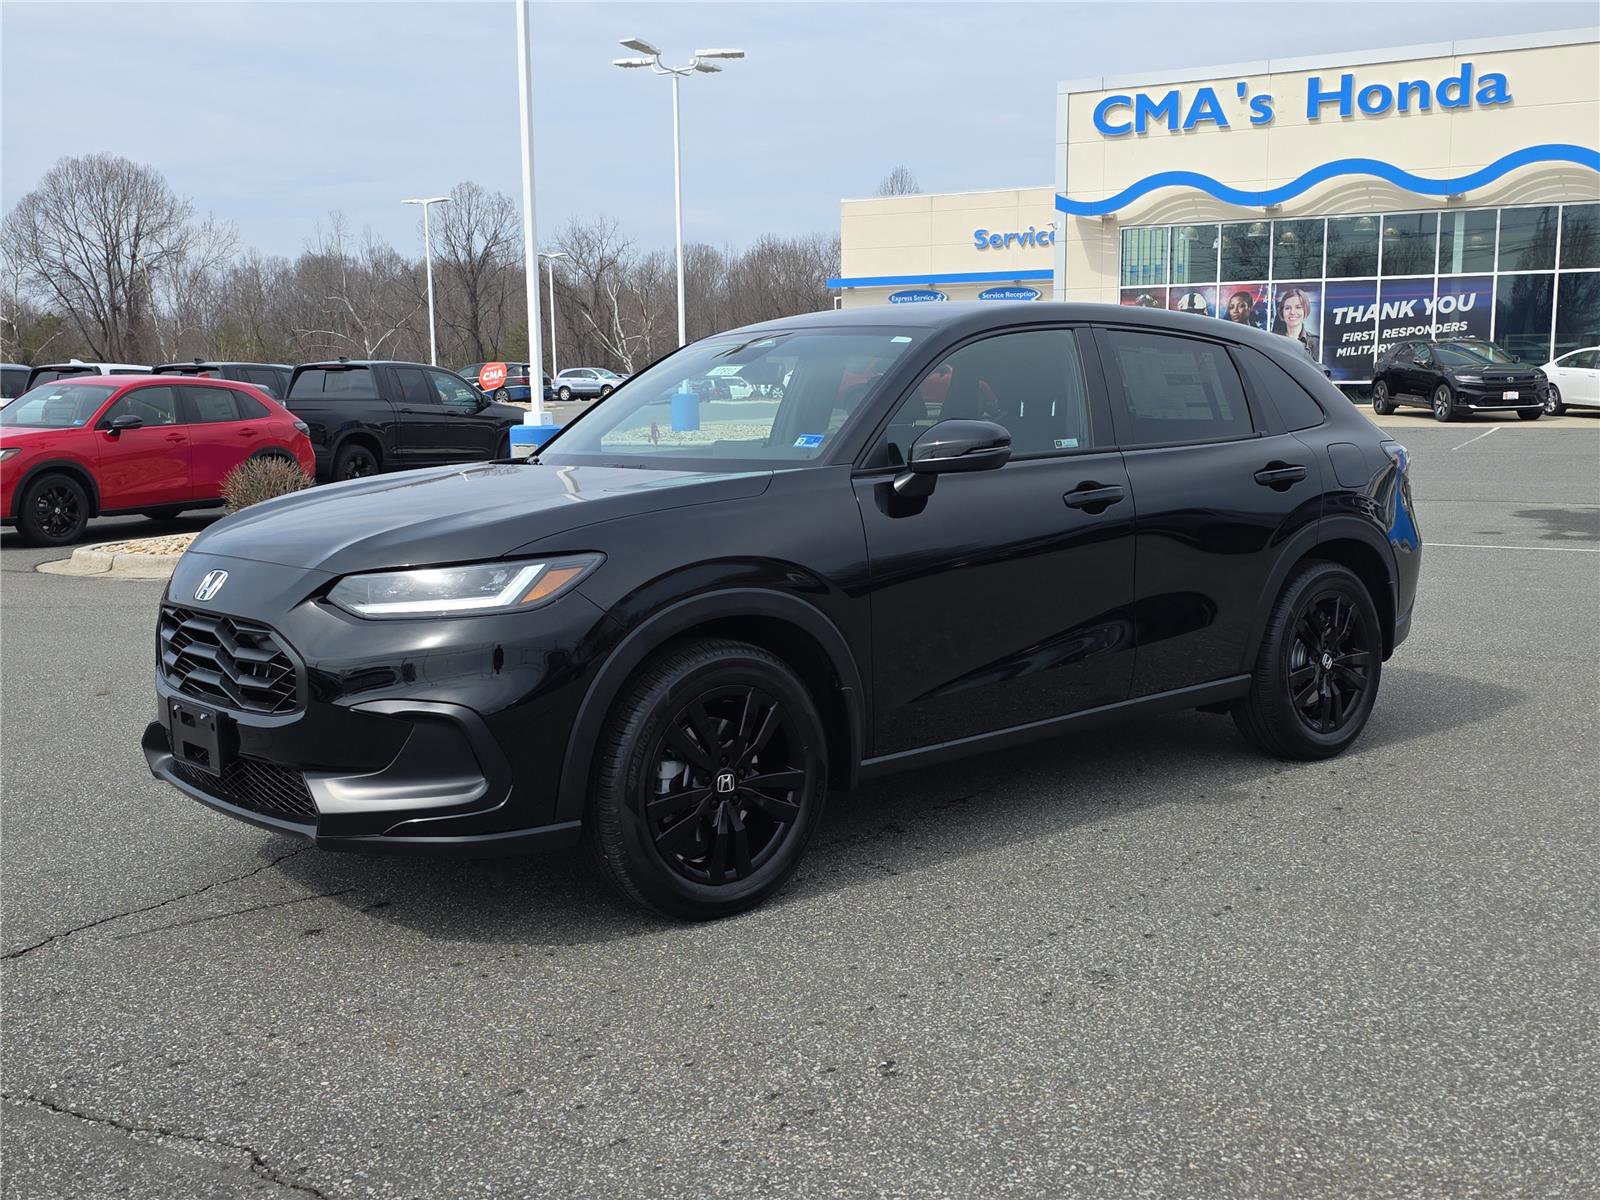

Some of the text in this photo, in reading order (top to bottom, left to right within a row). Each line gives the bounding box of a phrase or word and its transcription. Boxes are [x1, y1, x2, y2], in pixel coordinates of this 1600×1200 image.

[1093, 63, 1512, 136] CMA's Honda
[891, 294, 934, 303] Express Service
[1005, 290, 1036, 299] Reception
[1333, 293, 1476, 325] THANK YOU
[1341, 321, 1468, 343] FIRST RESPONDERS
[1336, 342, 1396, 357] MILITARY
[483, 369, 503, 380] CMA
